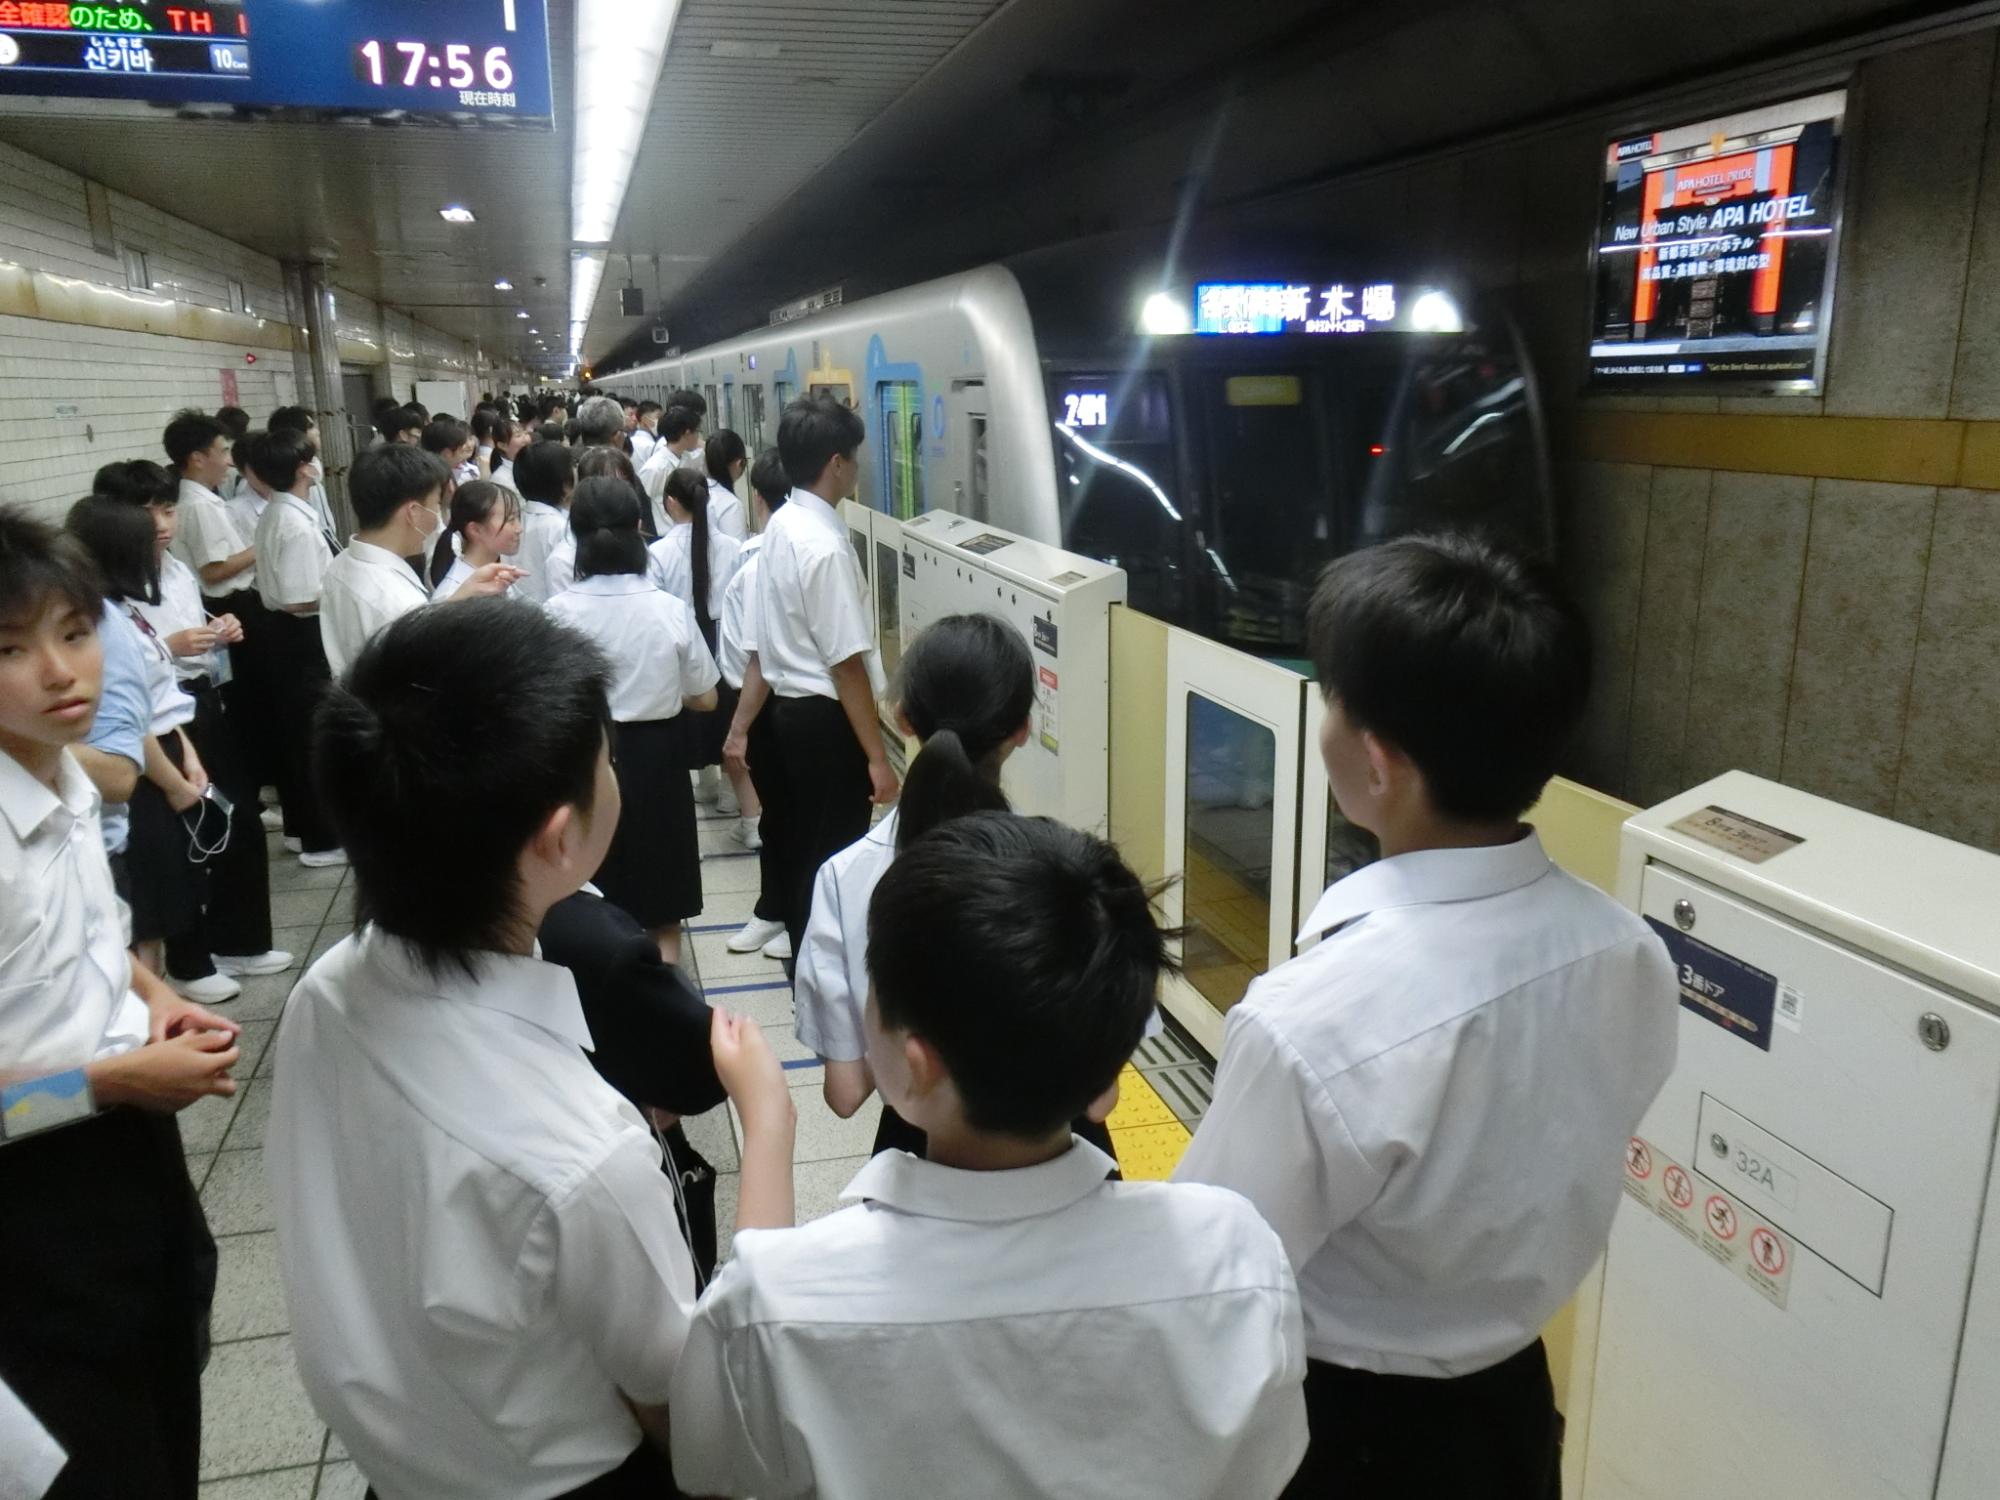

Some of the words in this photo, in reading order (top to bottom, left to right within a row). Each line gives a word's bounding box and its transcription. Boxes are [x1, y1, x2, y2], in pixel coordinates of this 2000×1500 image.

[90, 36, 142, 48] しんきば
[84, 47, 153, 72] 신키바
[214, 49, 231, 68] 10
[362, 40, 513, 90] 17:56
[459, 90, 516, 107] 現在時刻
[1630, 141, 1652, 154] HOTEL
[1676, 179, 1695, 191] APA
[1695, 174, 1725, 187] HOTEL
[1727, 168, 1753, 182] PRIDE
[1614, 226, 1639, 242] New
[1641, 220, 1674, 237] Urban
[1677, 214, 1708, 235] Style
[1709, 204, 1745, 230] APA
[1282, 284, 1395, 322] 新木場
[1681, 964, 1724, 997] 3番ドア
[1736, 1151, 1774, 1191] 32A
